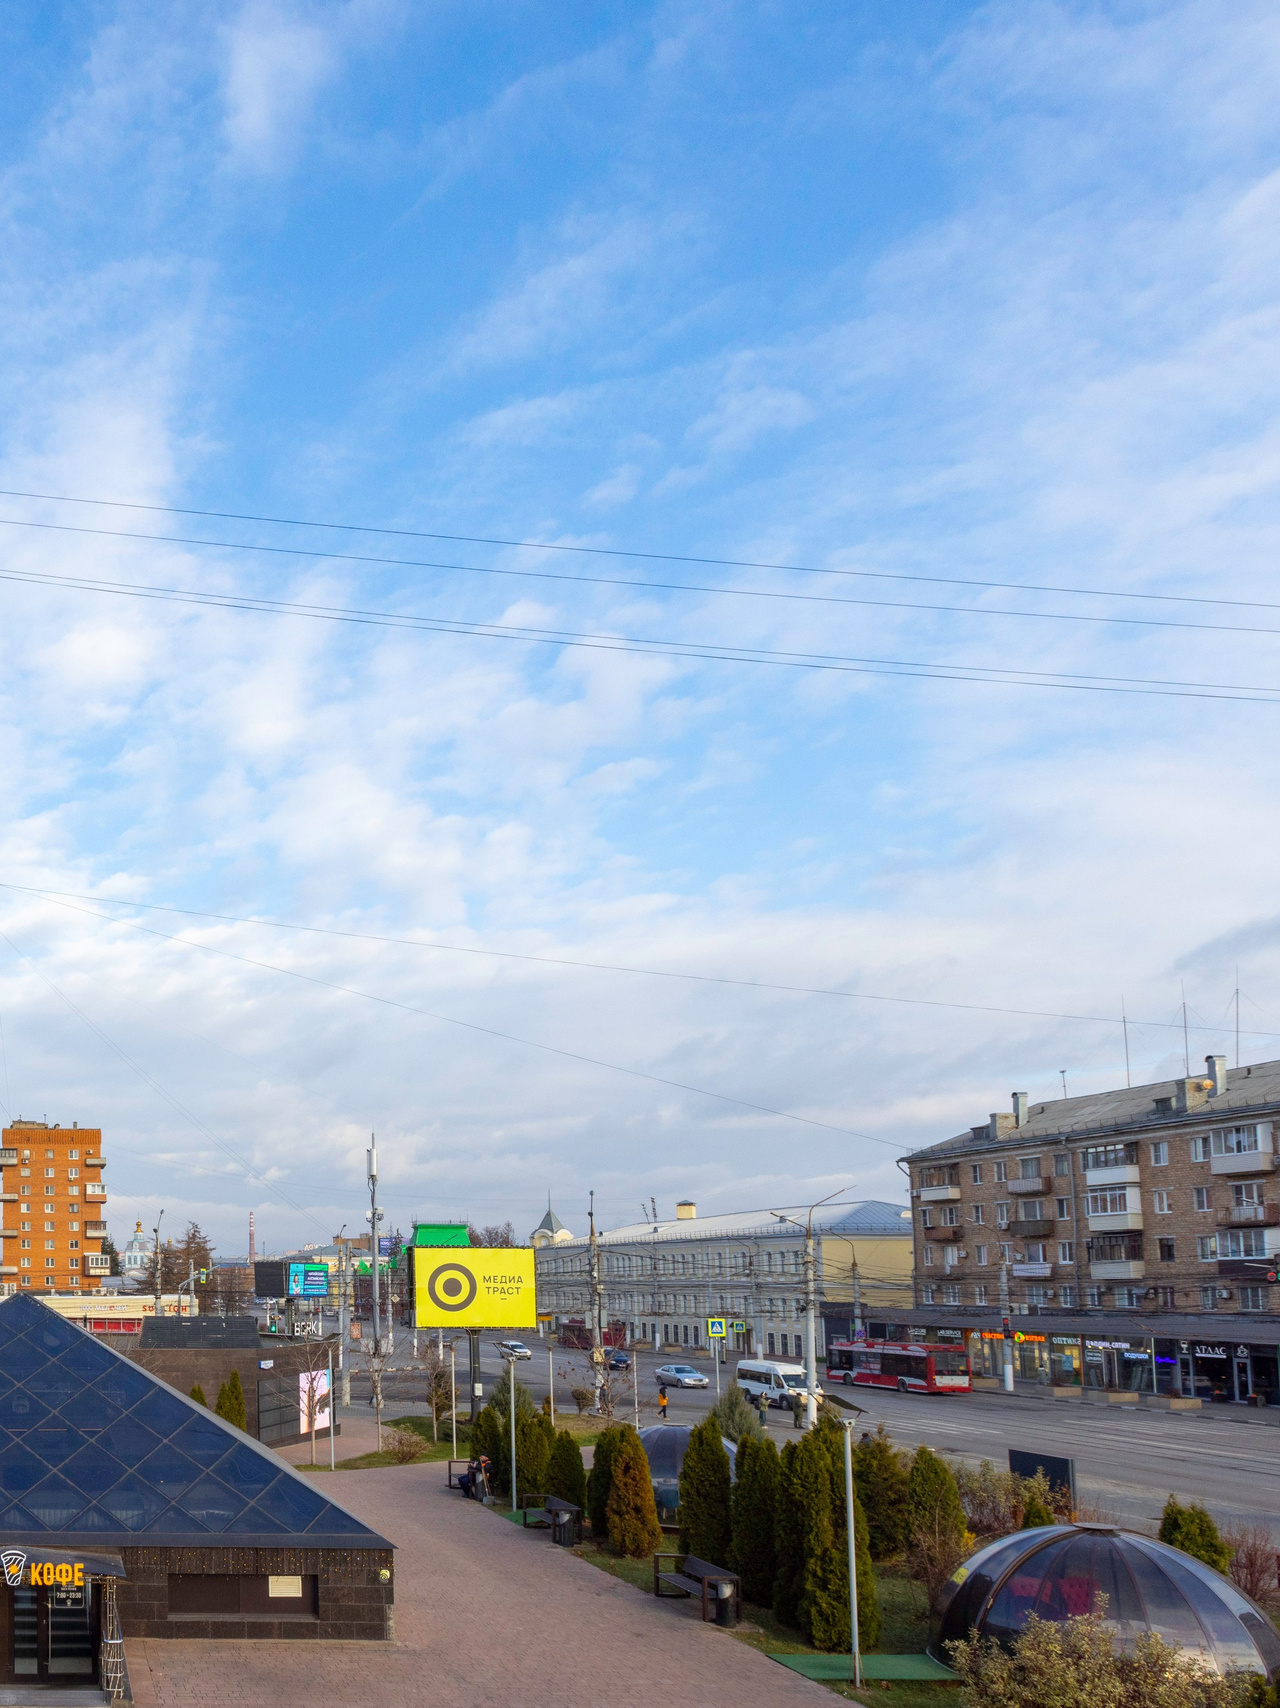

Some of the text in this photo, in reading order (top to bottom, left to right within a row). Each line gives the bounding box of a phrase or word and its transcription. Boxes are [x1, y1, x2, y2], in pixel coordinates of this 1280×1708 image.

[483, 1275, 523, 1284] МЕДИА
[486, 1287, 521, 1295] ТРАСТ
[1195, 1345, 1227, 1356] АТЛАС
[30, 1562, 84, 1586] КОФЕ
